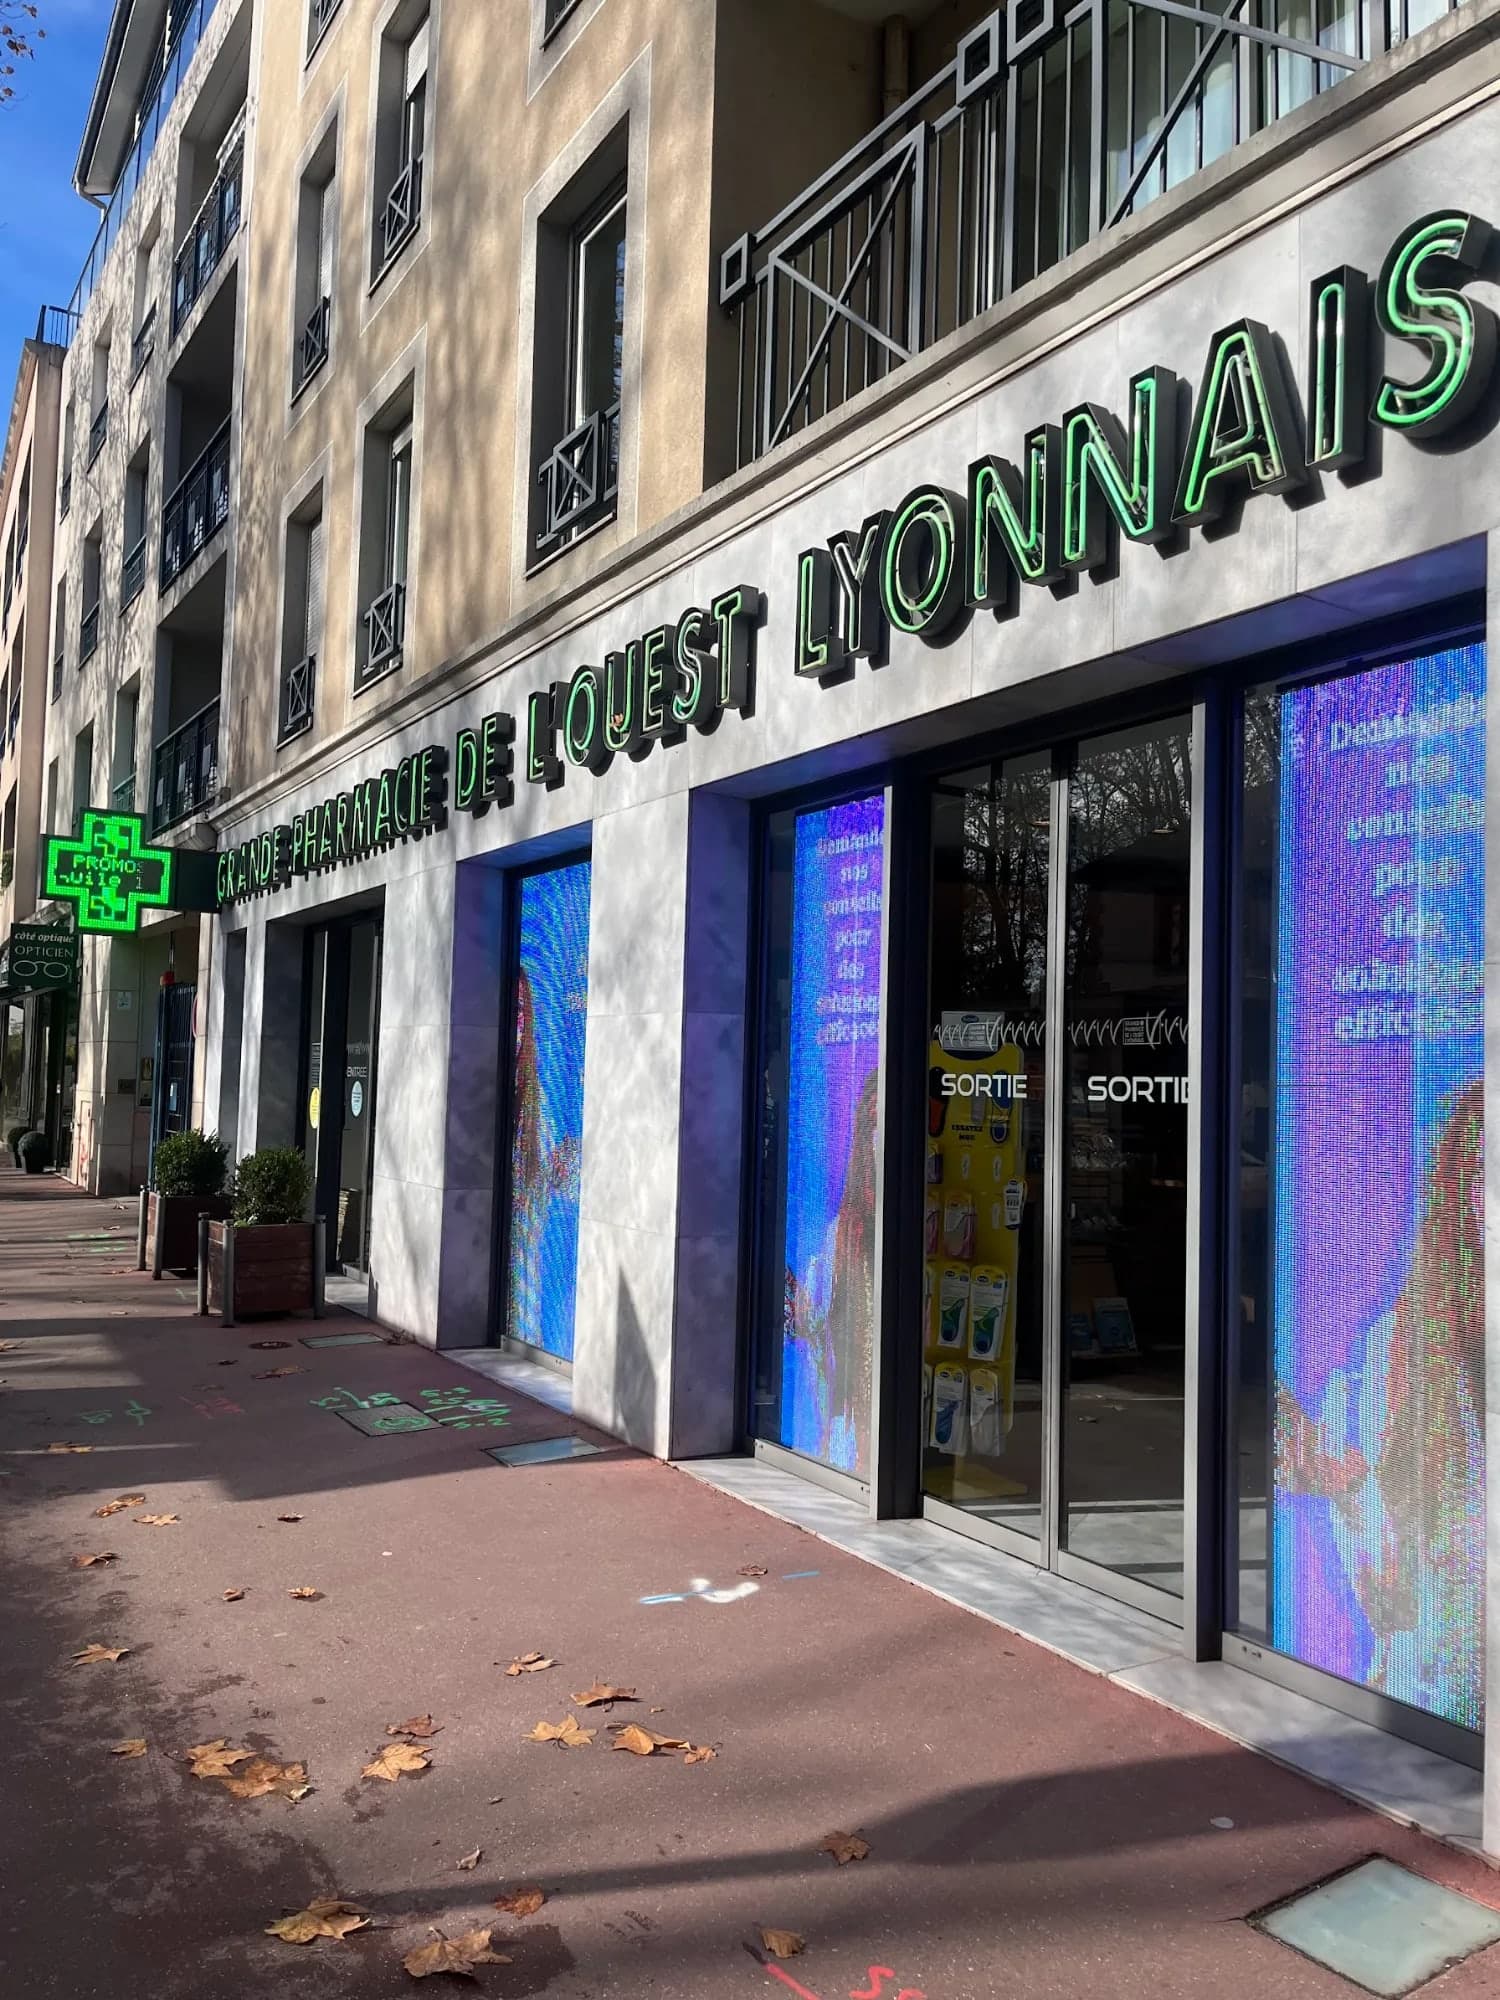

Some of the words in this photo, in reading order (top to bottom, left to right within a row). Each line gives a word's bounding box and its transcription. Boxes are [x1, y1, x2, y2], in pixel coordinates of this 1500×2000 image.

[216, 824, 292, 904] GRANDE
[292, 745, 445, 876] PHARMACIE
[456, 712, 513, 812] DE
[527, 584, 758, 784] L'OUEST
[795, 210, 1490, 677] LYONNAIS
[38, 933, 74, 943] optique
[15, 945, 74, 958] OPTICIEN
[941, 1074, 1028, 1098] SORTIE
